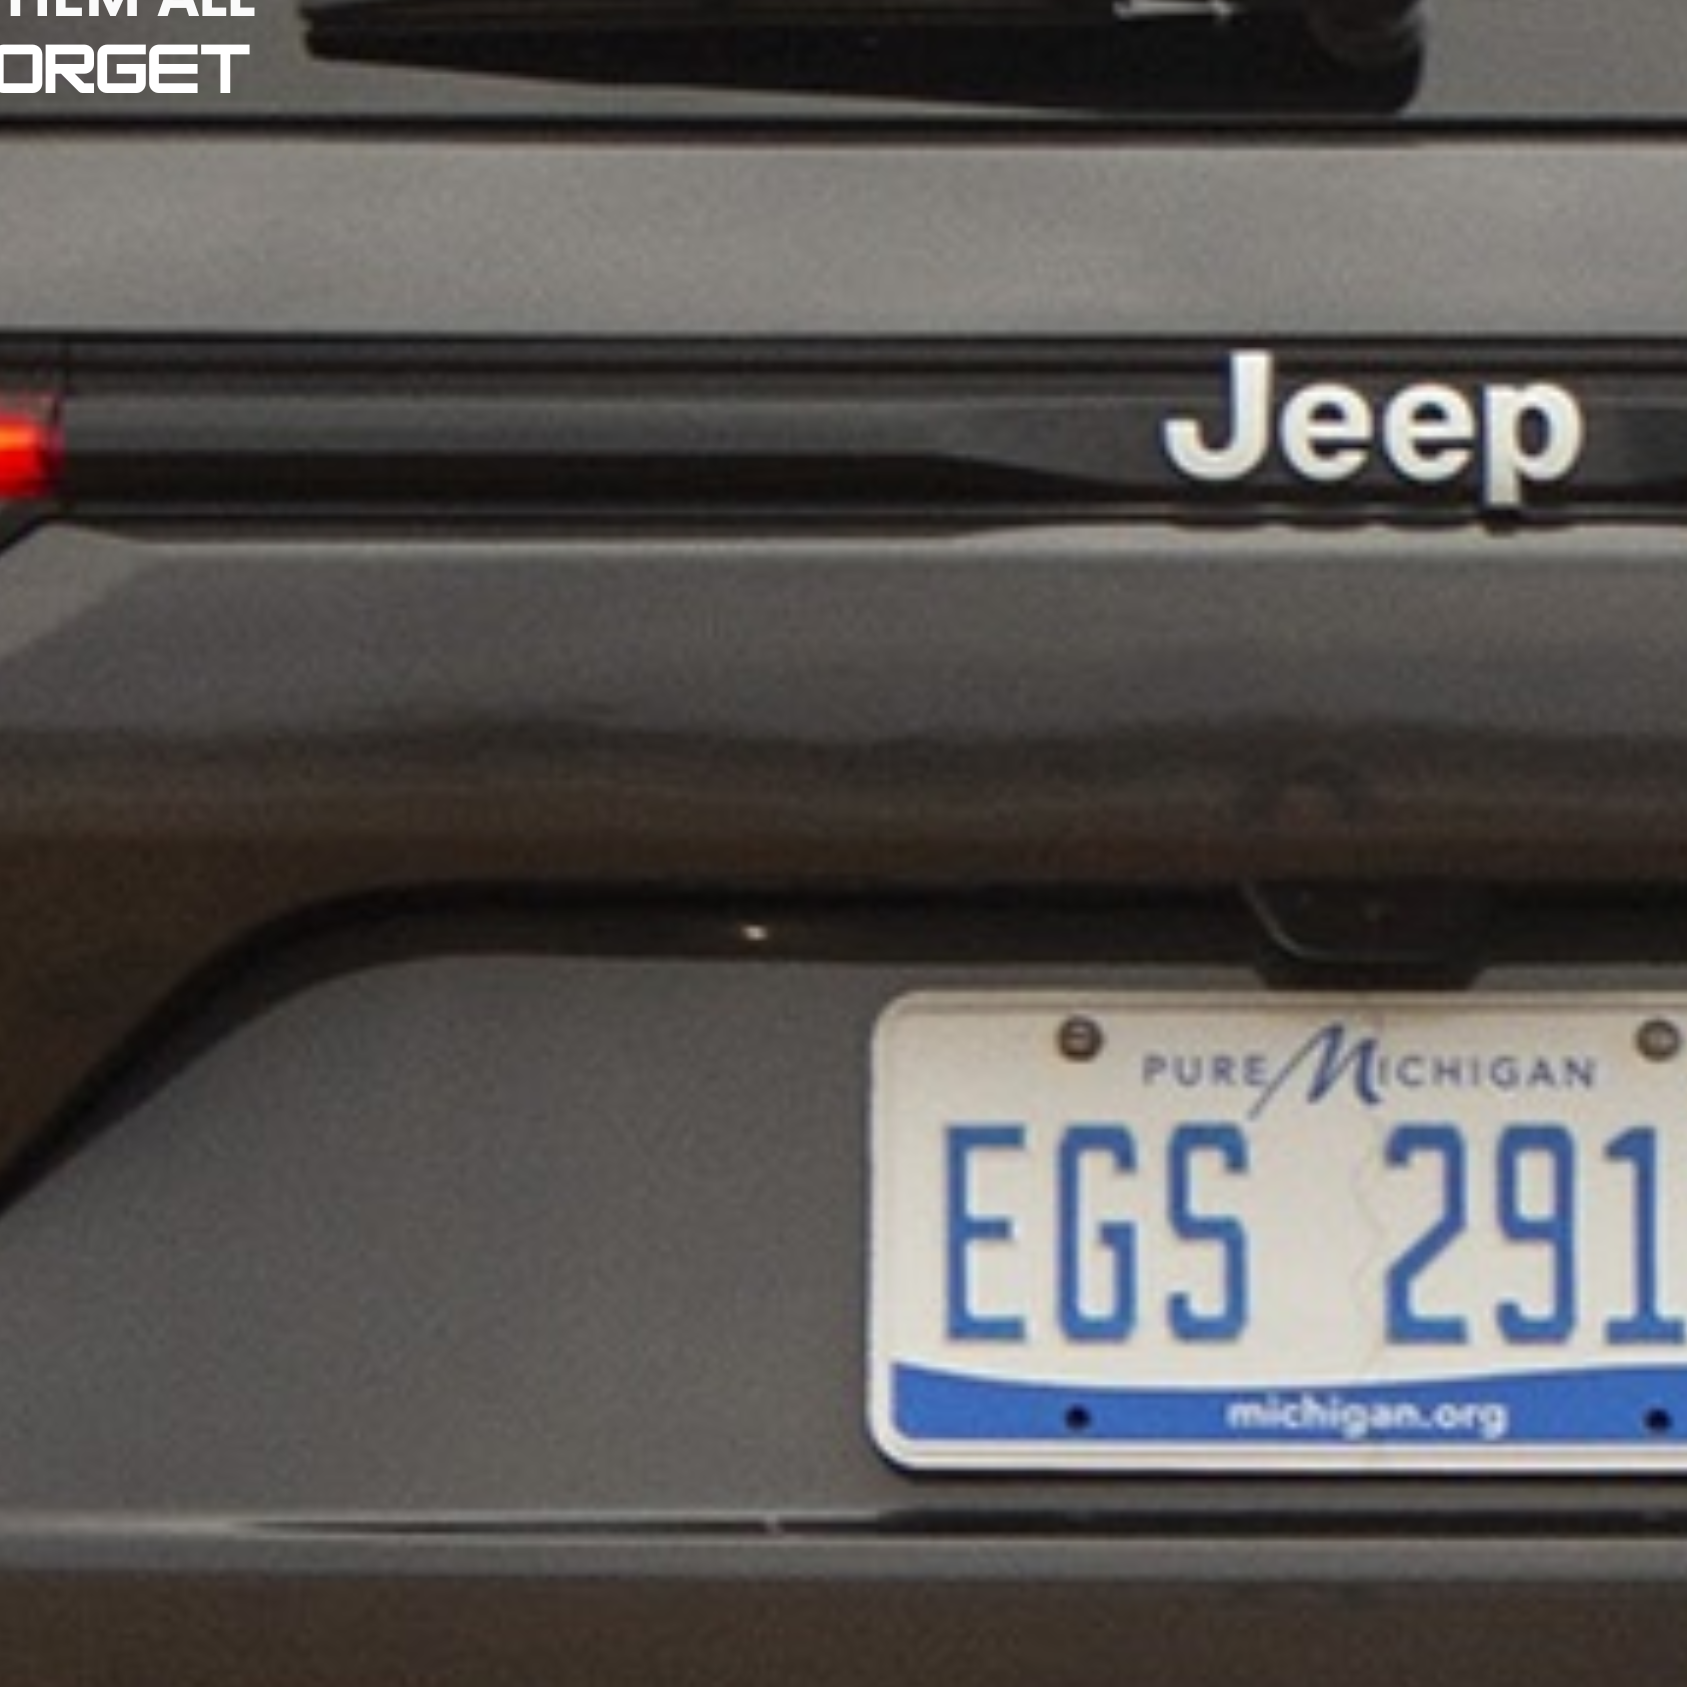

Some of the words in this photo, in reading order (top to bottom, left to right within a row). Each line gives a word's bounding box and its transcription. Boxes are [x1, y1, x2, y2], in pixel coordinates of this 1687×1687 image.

[1163, 349, 1586, 506] Jeep
[1141, 1054, 1269, 1087] PURE
[1247, 1022, 1596, 1119] MICHIGAN
[944, 1125, 1248, 1345] EGS
[1383, 1125, 1686, 1345] 291
[1227, 1395, 1508, 1441] michigan.org
